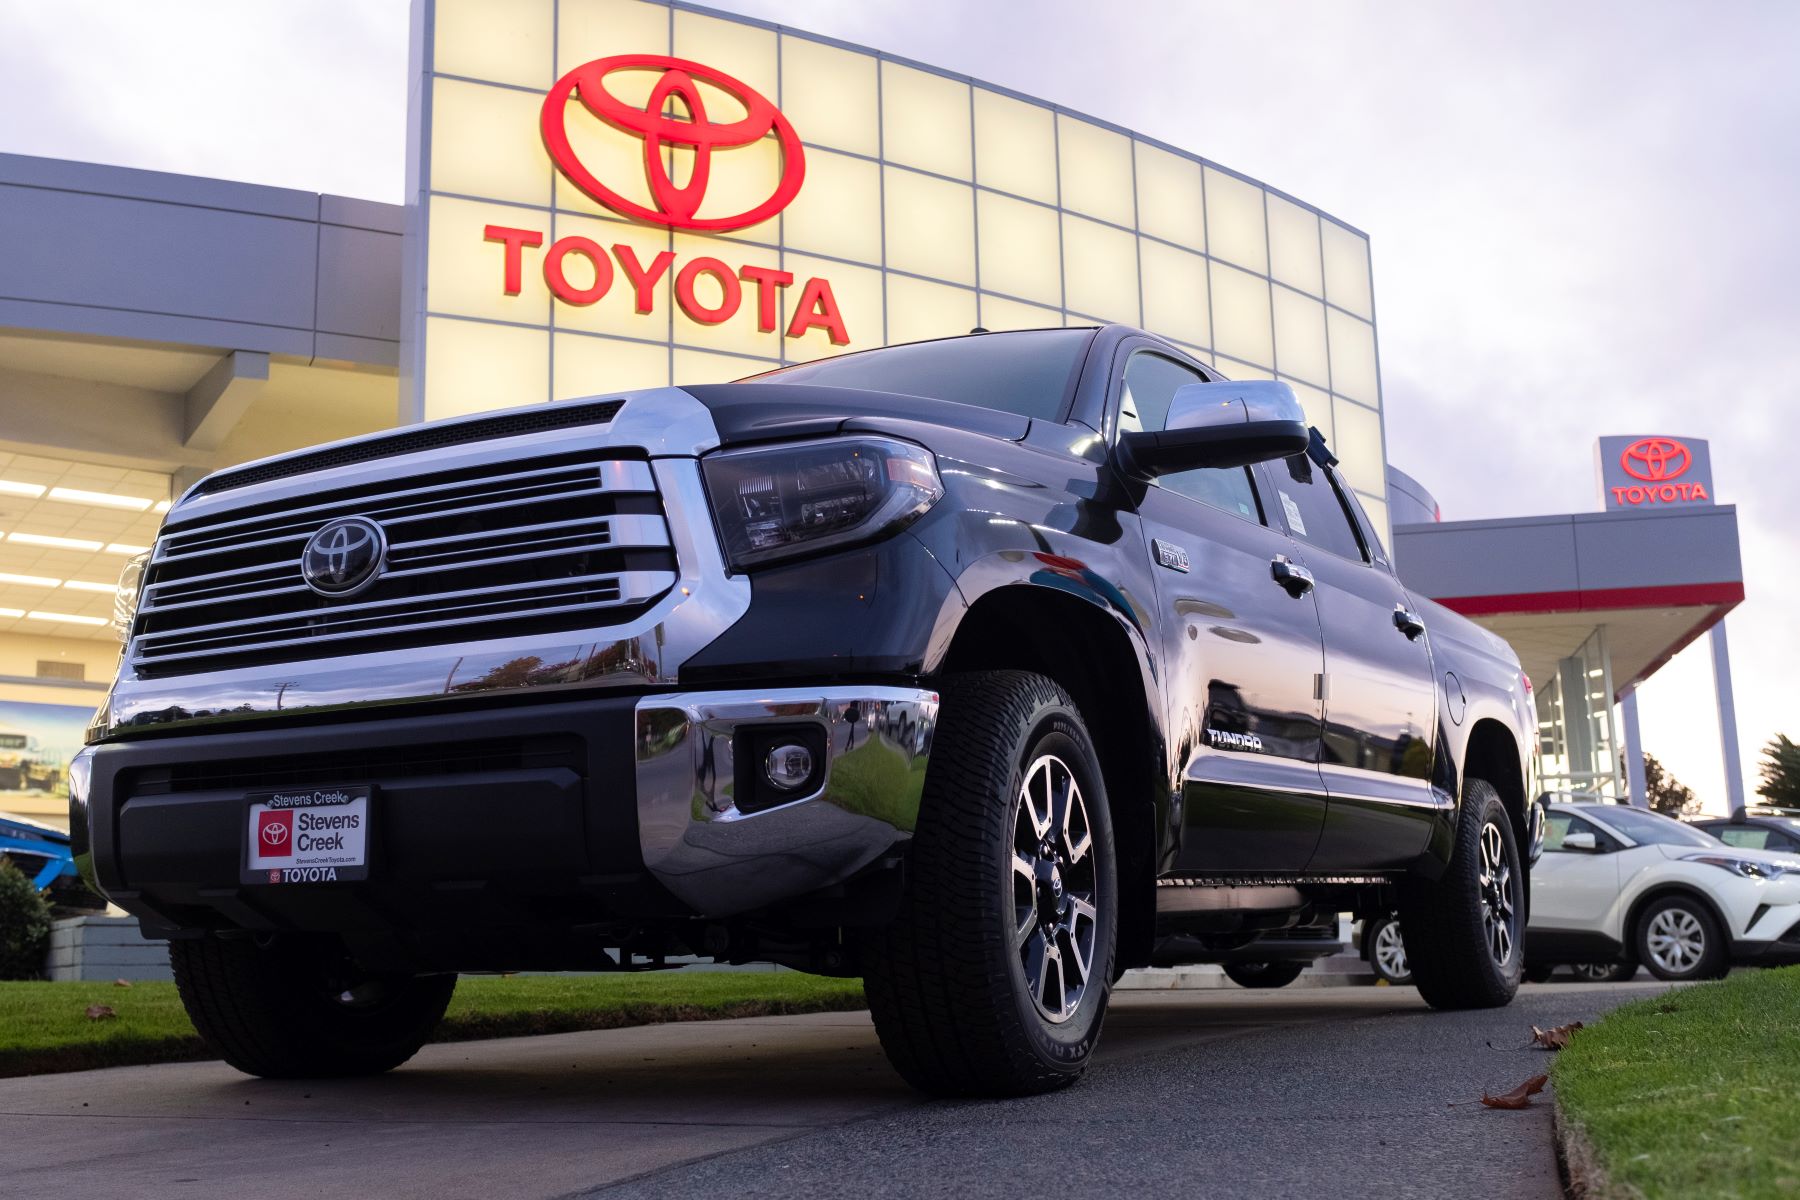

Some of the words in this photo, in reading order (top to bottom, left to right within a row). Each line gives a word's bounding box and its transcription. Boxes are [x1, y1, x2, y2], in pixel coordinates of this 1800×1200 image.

[483, 224, 851, 346] TOYOTA
[1611, 482, 1709, 505] TOYOTA
[273, 794, 311, 807] Stevens
[313, 790, 343, 805] Creek
[298, 813, 359, 831] Stevens
[297, 832, 344, 851] Creek
[296, 856, 356, 865] StevensCreekToyota.com
[283, 867, 337, 882] TOYOTA
